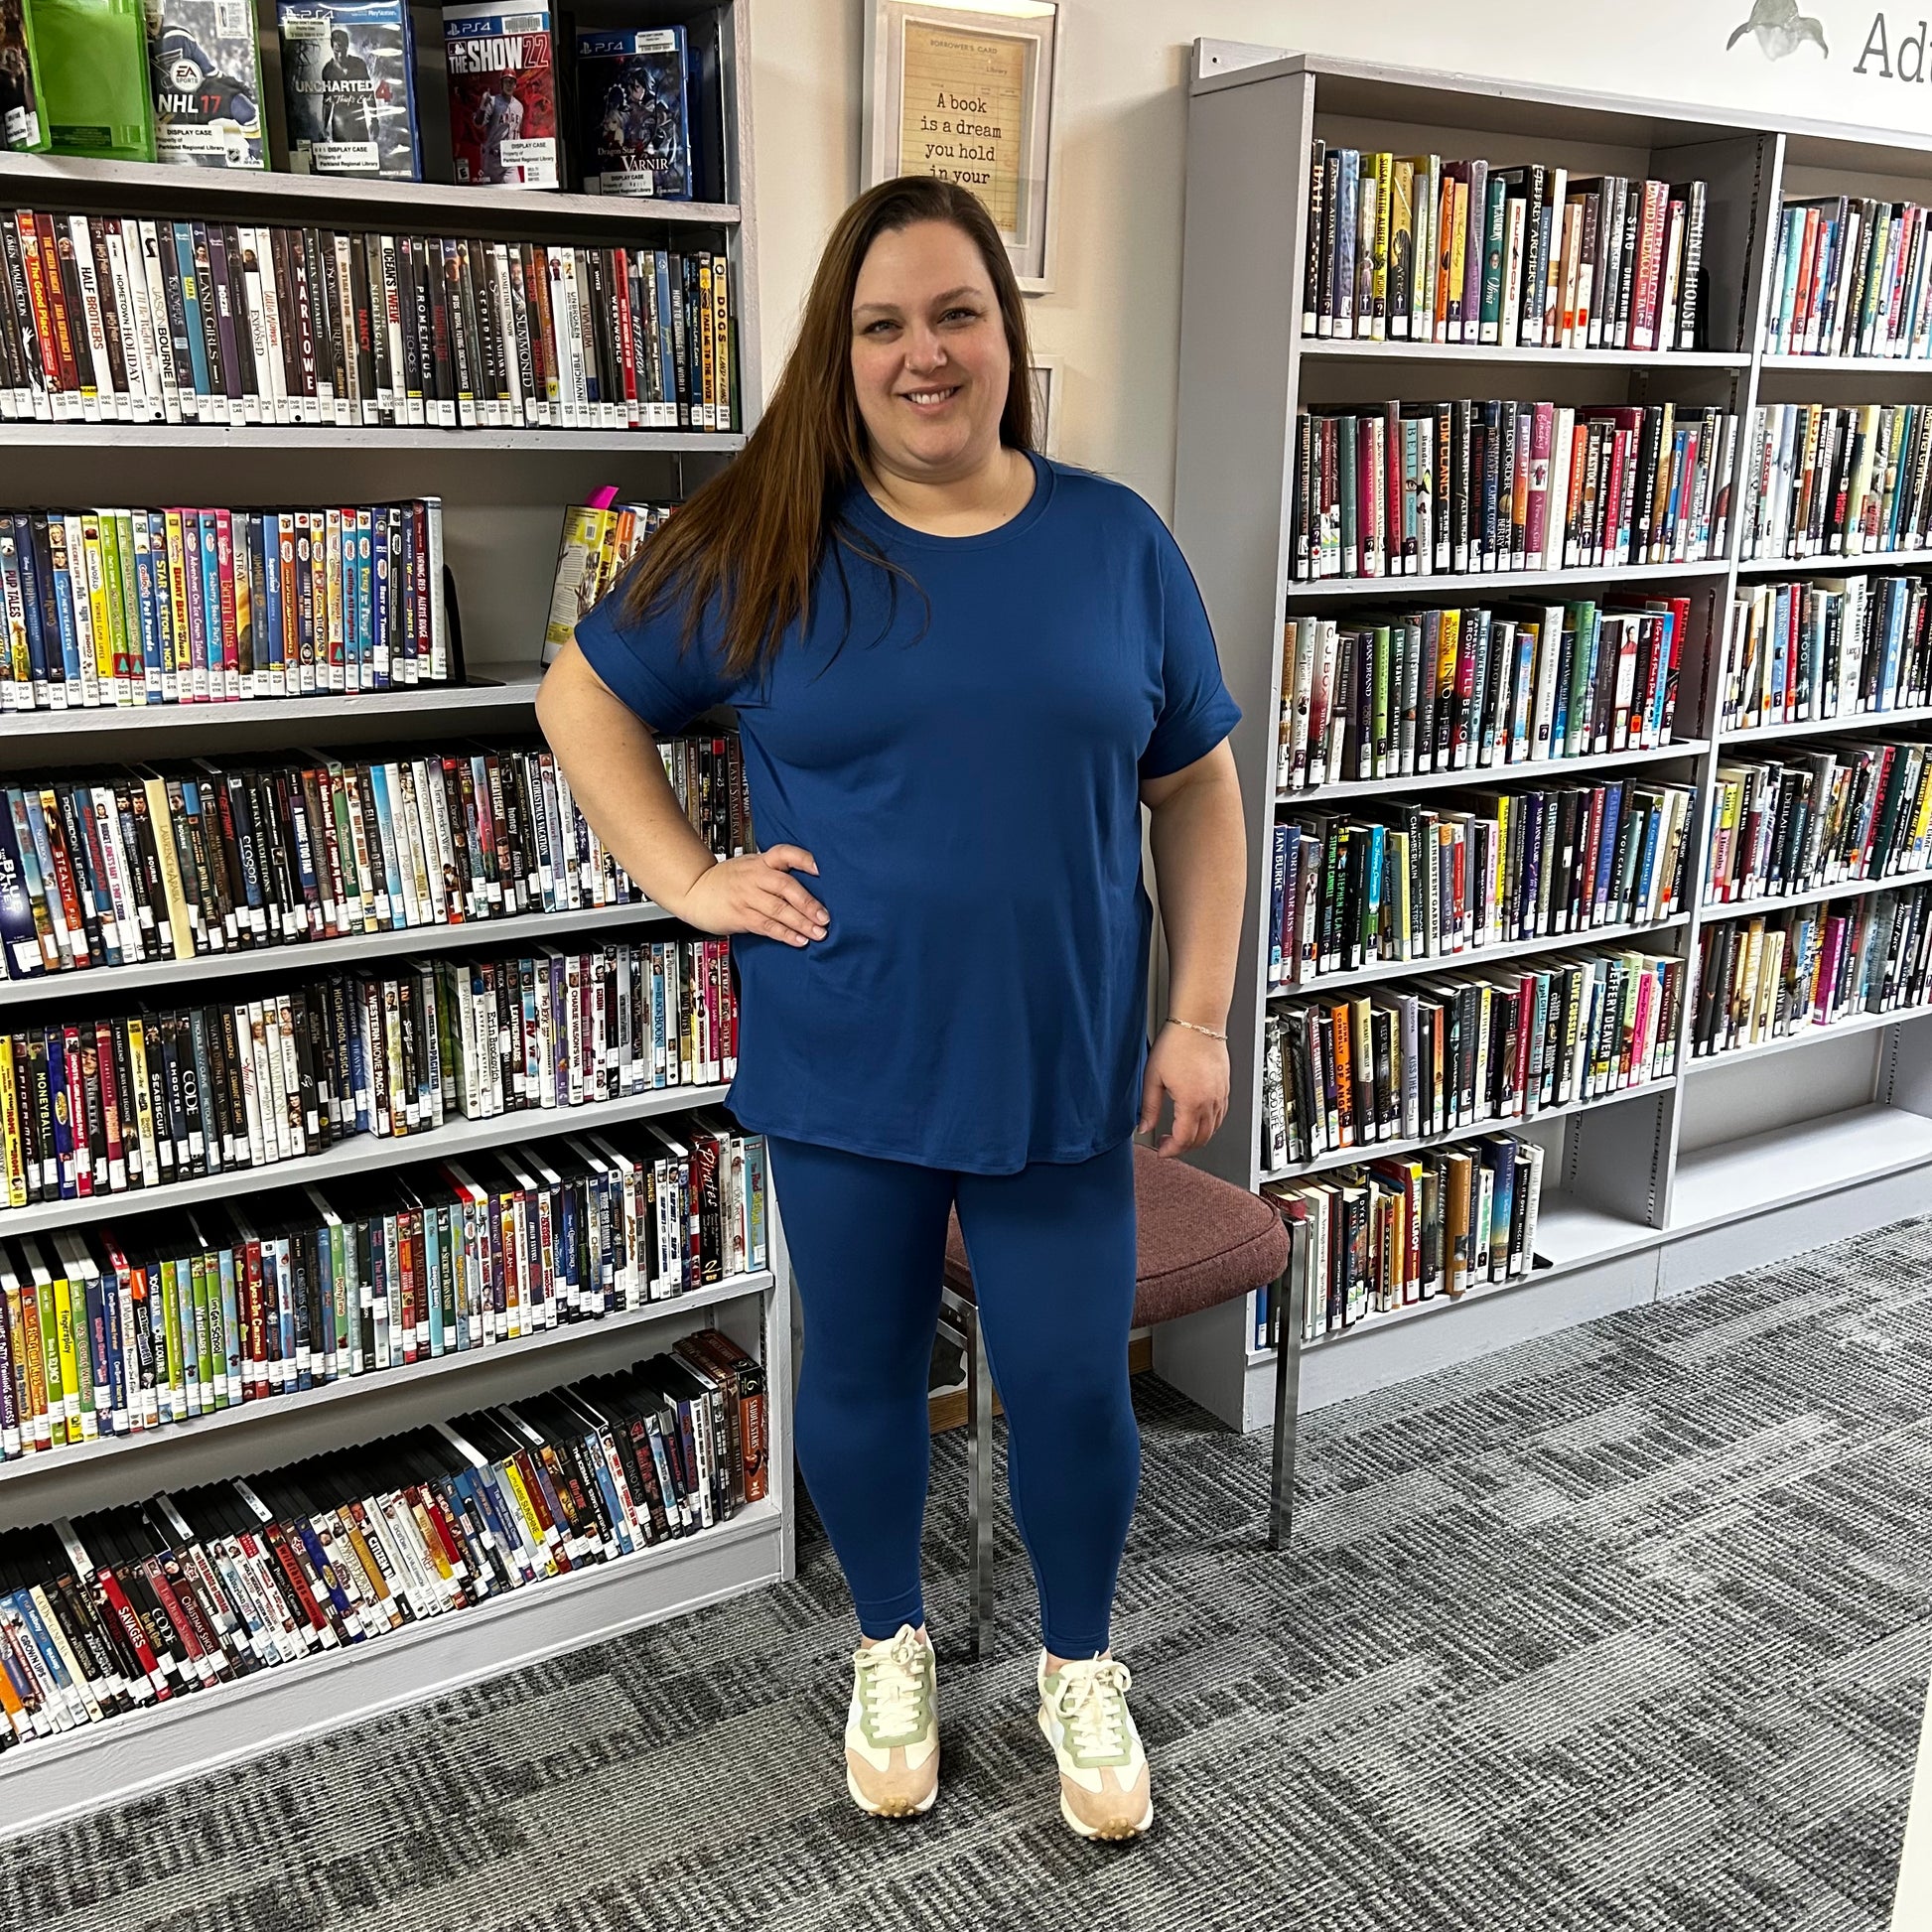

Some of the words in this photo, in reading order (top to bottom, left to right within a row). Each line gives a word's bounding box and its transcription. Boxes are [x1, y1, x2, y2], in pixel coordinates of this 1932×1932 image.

[462, 22, 491, 33] PS4
[450, 55, 469, 73] THE
[469, 38, 523, 70] SHOW
[523, 34, 548, 69] 22
[596, 42, 624, 52] PS4
[930, 40, 974, 52] BORROWER'S
[1853, 12, 1932, 83] Ad
[176, 66, 197, 77] EA
[986, 66, 1008, 75] Library
[159, 94, 199, 113] NHL
[201, 94, 221, 114] 17
[296, 79, 375, 93] UNCHARTED
[375, 79, 393, 102] 4
[937, 92, 946, 108] A
[950, 94, 987, 113] book
[920, 116, 937, 131] is
[943, 122, 951, 133] a
[956, 121, 1002, 139] dream
[598, 147, 621, 157] Dragon
[621, 146, 635, 156] Star
[621, 155, 669, 172] VARNIR
[924, 142, 954, 159] you
[959, 143, 996, 162] hold
[929, 165, 948, 180] in
[952, 171, 990, 186] your
[1379, 159, 1388, 186] SUSAN
[1378, 188, 1387, 213] WITTIG
[1646, 185, 1657, 219] DAVID
[307, 237, 319, 278] MATRIX
[1639, 222, 1654, 278] BALDACCI
[1686, 221, 1704, 272] NINTH
[30, 261, 41, 279] The
[81, 267, 95, 293] HALF
[383, 248, 398, 286] OCEAN'S
[34, 281, 45, 308] Good
[152, 287, 166, 327] JASON
[387, 289, 400, 324] TWELVE
[1485, 278, 1500, 305] Olivia
[1682, 277, 1698, 329] HOUSE
[40, 310, 50, 337] Place
[85, 296, 103, 350] BROTHERS
[116, 274, 130, 325] HOMETOWN
[123, 328, 140, 383] HOLIDAY
[199, 272, 213, 312] LAND
[206, 318, 218, 359] GIRLS
[296, 267, 314, 390] MARLOWE
[312, 283, 324, 338] RELOADED
[371, 284, 384, 359] NIGHTINGALE
[570, 292, 581, 338] UNBROKEN
[581, 304, 593, 348] VIVARIUM
[632, 316, 642, 336] WET
[717, 298, 726, 343] DOGS
[250, 310, 264, 356] EXPOSED
[358, 309, 370, 351] NANCY
[417, 286, 431, 379] PROMETHEUS
[612, 296, 621, 363] WESTWORLD
[705, 336, 712, 347] ME
[157, 328, 173, 377] BOURNE
[406, 336, 416, 373] ECHOES
[516, 314, 533, 387] SUMMONED
[633, 338, 644, 377] SEASON
[705, 349, 712, 360] TO
[572, 352, 584, 401] INVINCIBLE
[1407, 428, 1416, 473] BELL
[1505, 430, 1514, 455] LOST
[1503, 457, 1512, 489] ORDER
[1586, 436, 1599, 488] BLACKSTOCK
[5, 571, 16, 587] PUP
[156, 560, 167, 589] STAR
[174, 567, 183, 598] BERRY
[190, 556, 199, 592] Adventures
[235, 553, 246, 583] STRAY
[193, 594, 201, 605] On
[209, 572, 218, 604] Seaberry
[221, 578, 232, 615] Berry
[8, 596, 21, 618] TALES
[178, 631, 188, 658] Show
[194, 618, 203, 639] Cream
[223, 620, 235, 647] Tales
[1879, 751, 1894, 794] PETER
[62, 796, 79, 852] POSEIDON
[218, 796, 234, 841] GETAWAY
[295, 814, 308, 842] BRIDGE
[507, 807, 517, 834] honey
[532, 779, 542, 821] CHRISTMAS
[538, 821, 548, 856] VACATION
[1869, 798, 1883, 845] JAMES
[242, 836, 257, 885] eragon
[299, 843, 310, 859] TOO
[1275, 832, 1286, 853] JAN
[55, 851, 73, 901] STEALTH
[302, 860, 313, 874] FAR
[1274, 856, 1286, 892] BURKE
[1605, 966, 1621, 1013] JEFFERY
[368, 995, 380, 1041] WESTERN
[487, 1012, 497, 1035] Erin
[509, 1005, 521, 1061] LEATHERHEADS
[372, 1041, 382, 1069] MOVIE
[1600, 1016, 1615, 1058] DEAVER
[489, 1037, 499, 1083] Brockovich
[170, 1061, 181, 1113] SHOOTER
[375, 1071, 384, 1096] PACK
[36, 1072, 52, 1140] MONEYBALL
[152, 1073, 165, 1137] SEABISCUIT
[698, 1148, 718, 1208] Pirates
[505, 1231, 515, 1269] AKEELAH
[149, 1274, 159, 1293] YOGI
[507, 1286, 516, 1301] BEE
[150, 1295, 160, 1316] BEAR
[60, 1311, 72, 1354] fingersplay
[117, 1606, 146, 1649] SAVAGES
[181, 1595, 206, 1632] CHRISTMAS
[199, 1631, 215, 1654] SHOES
